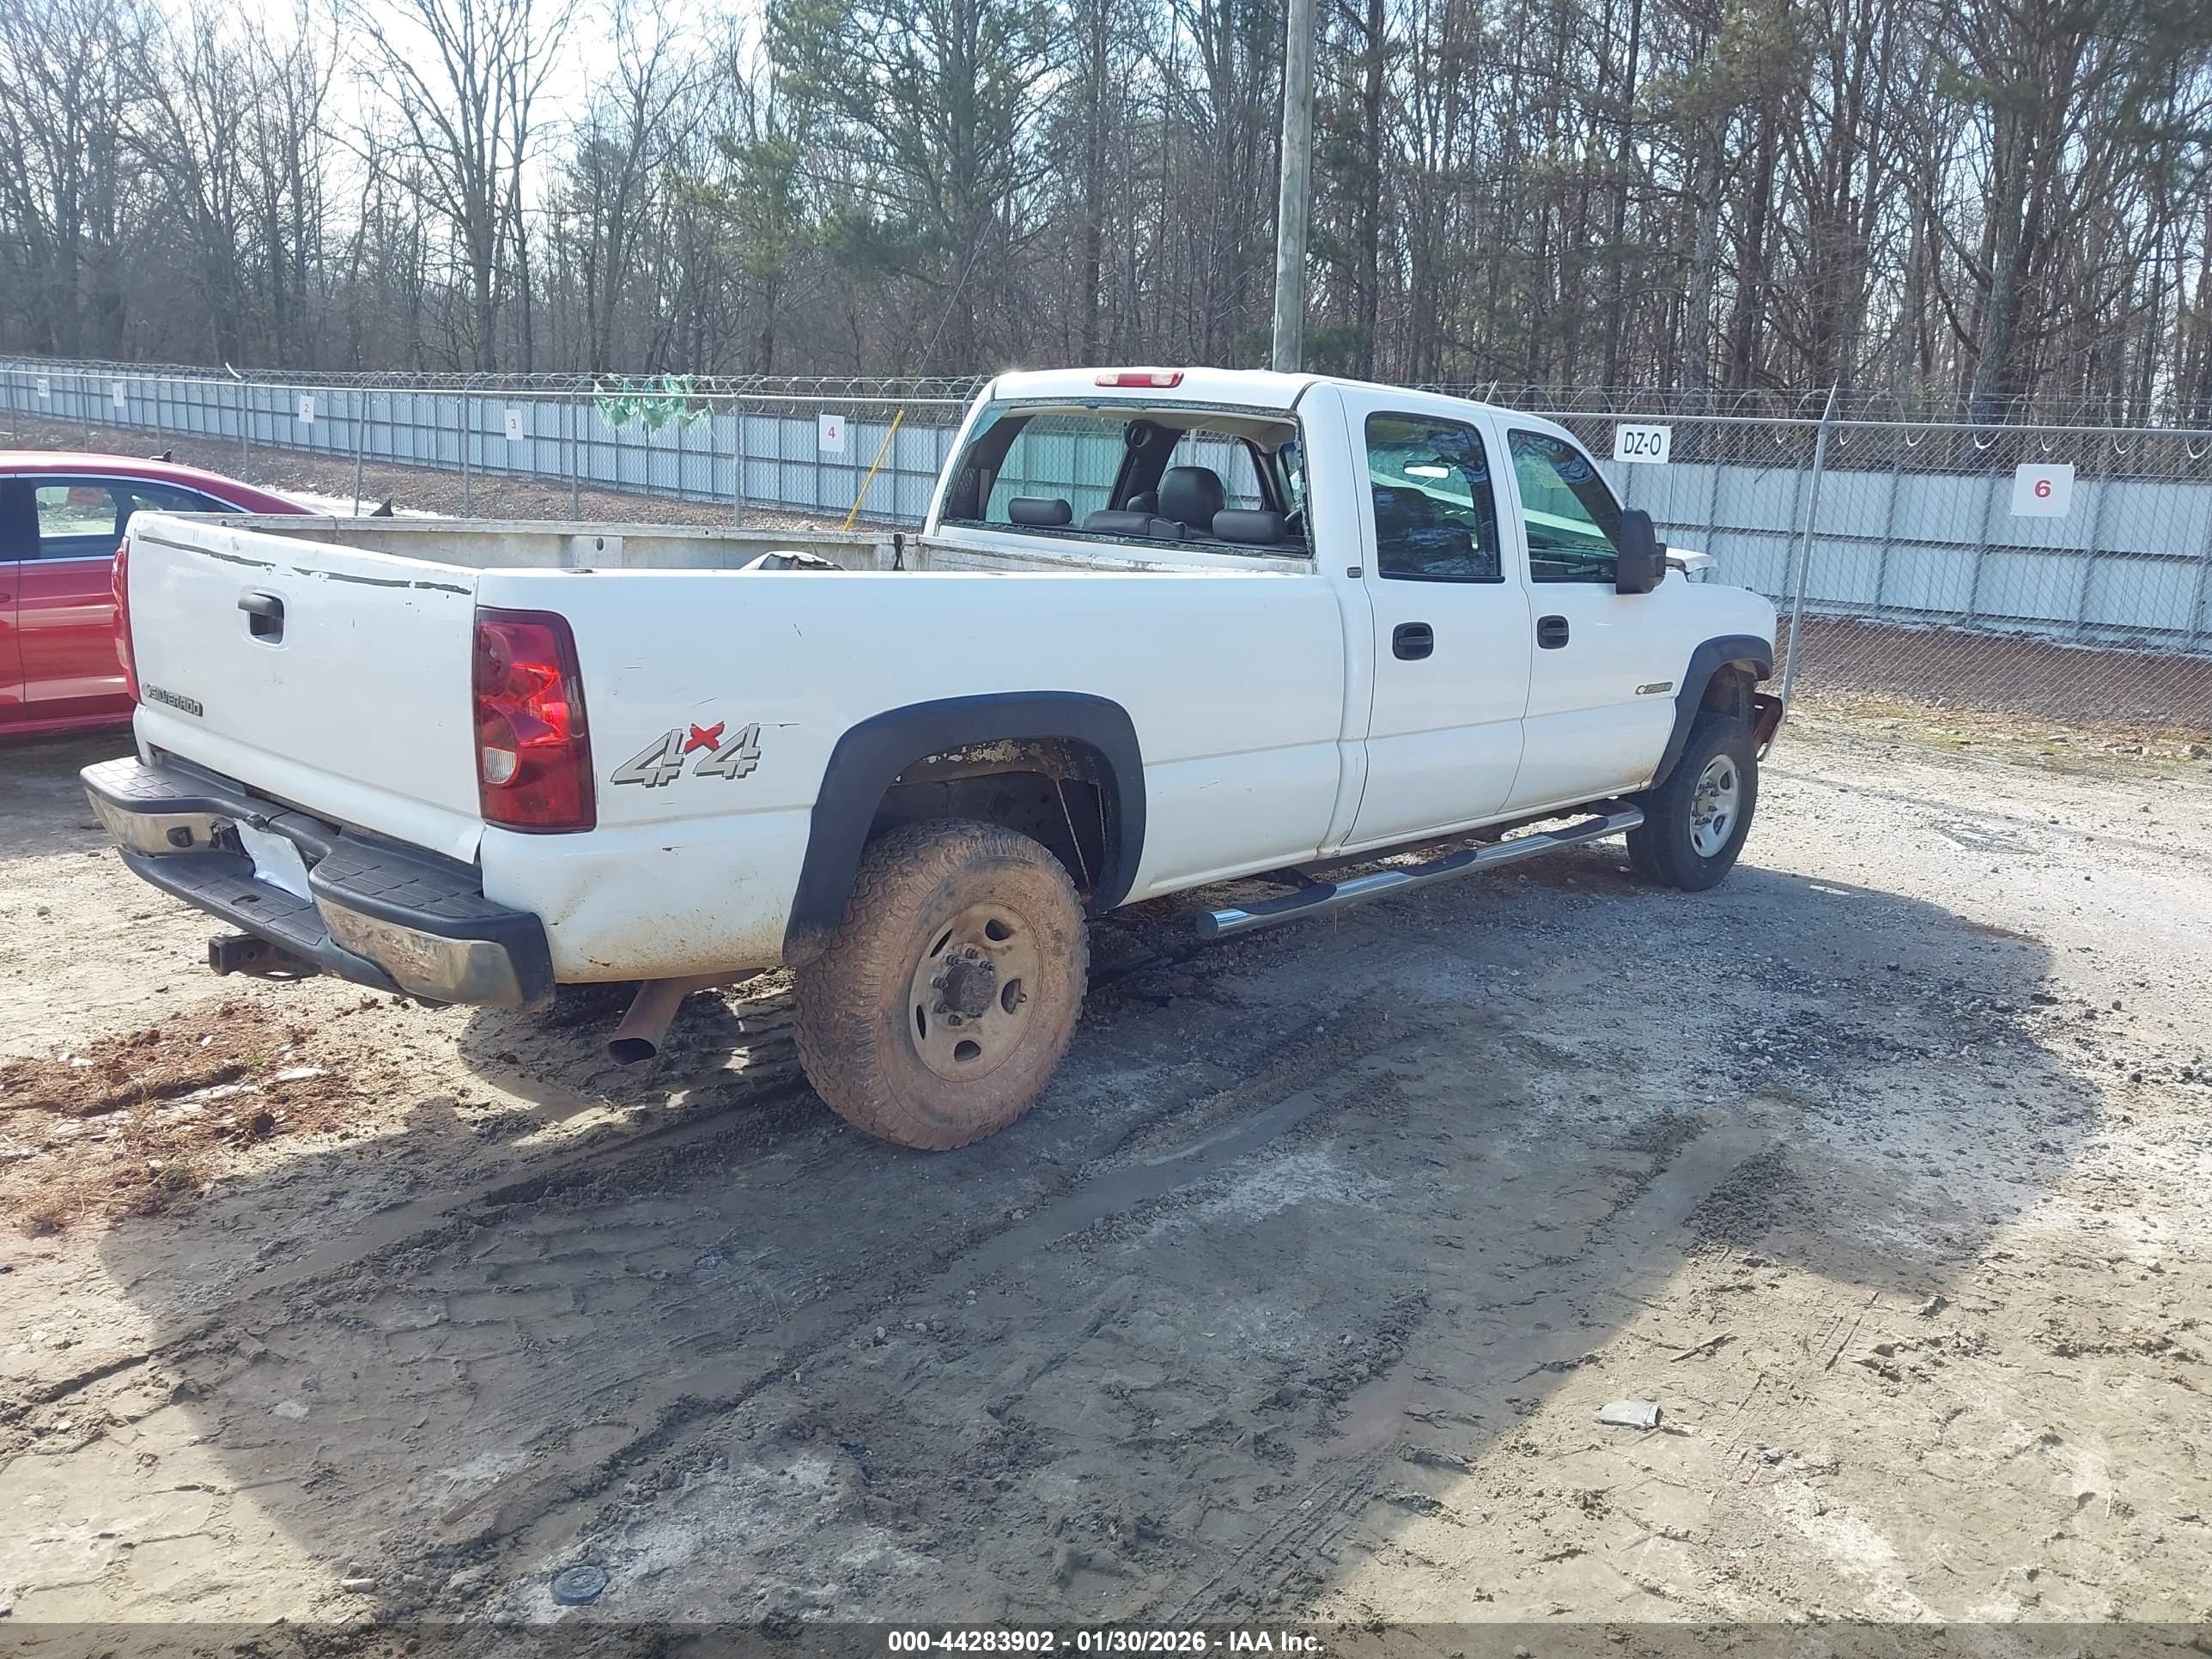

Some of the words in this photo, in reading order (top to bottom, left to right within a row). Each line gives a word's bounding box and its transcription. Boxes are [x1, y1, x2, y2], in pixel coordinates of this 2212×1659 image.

[828, 426, 836, 440] 4
[2035, 480, 2051, 498] 6
[149, 687, 202, 716] SILVERADO
